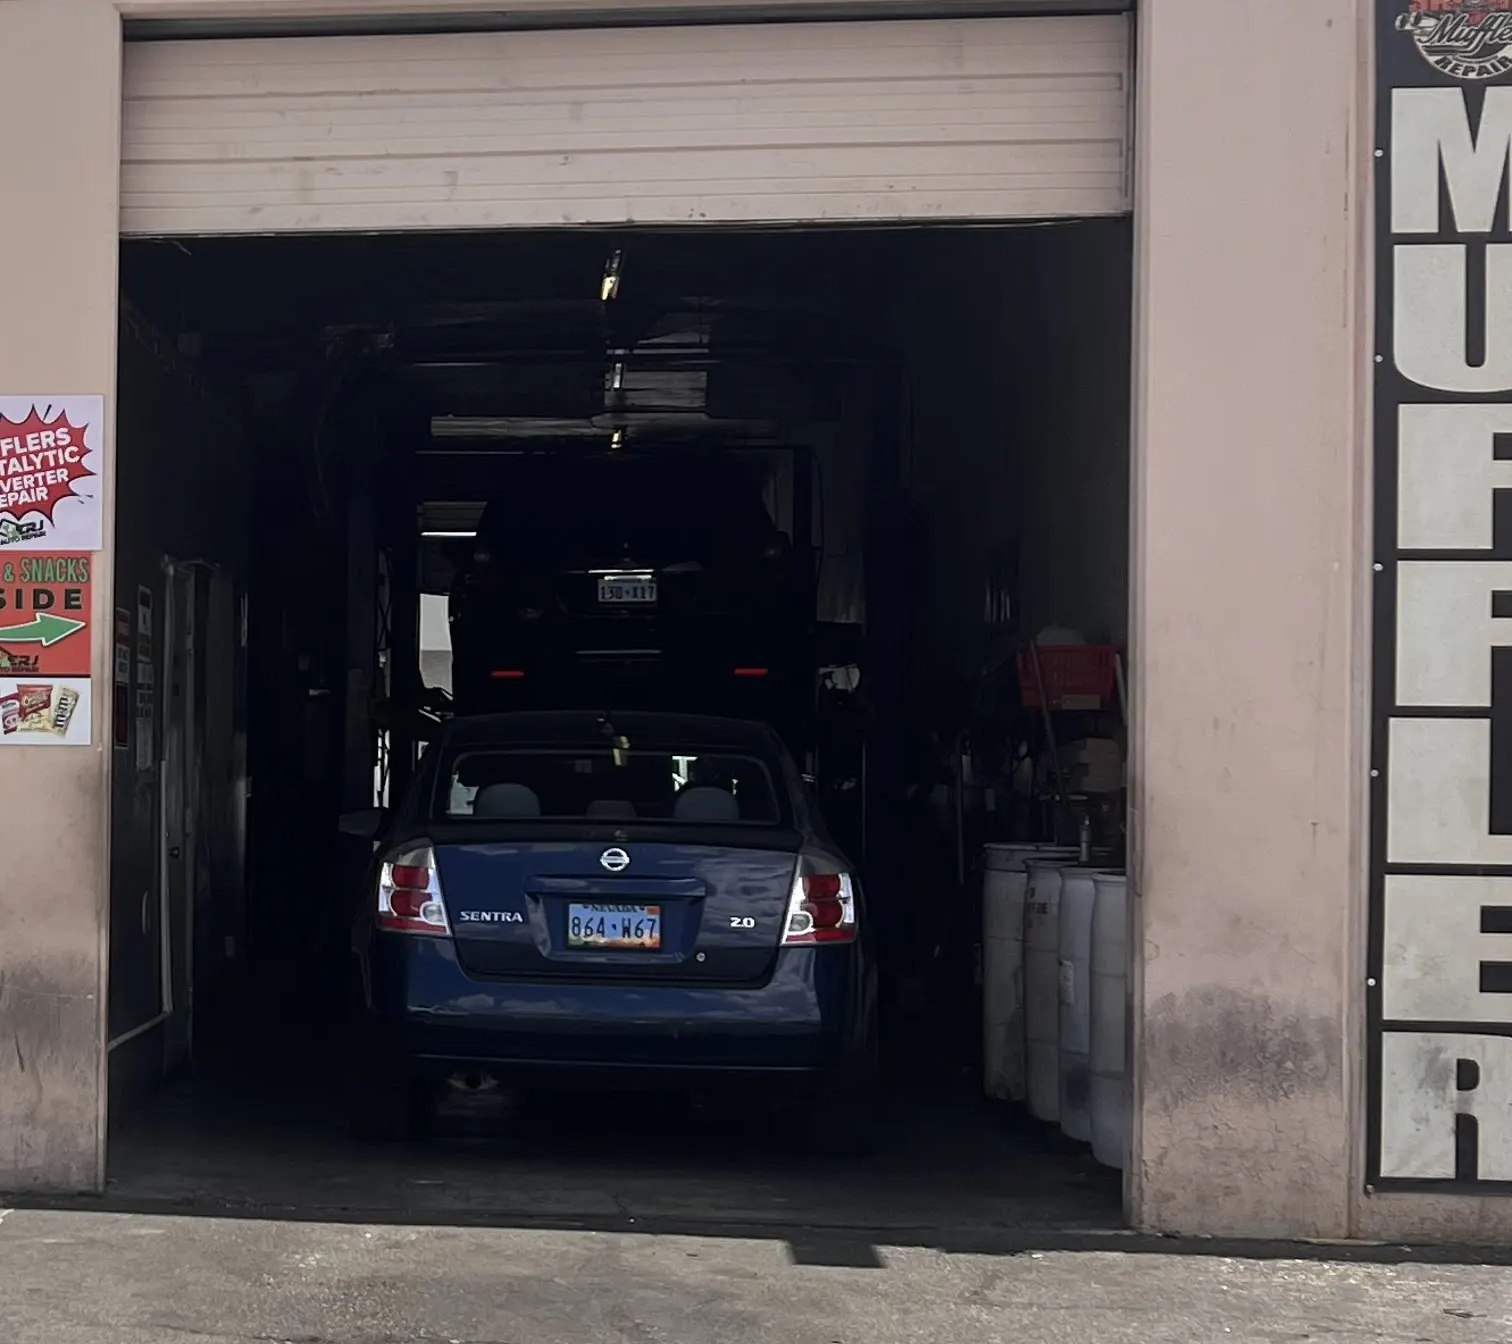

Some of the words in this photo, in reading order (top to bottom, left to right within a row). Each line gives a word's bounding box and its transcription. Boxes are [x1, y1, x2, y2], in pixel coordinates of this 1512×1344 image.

[4, 561, 15, 583] &
[20, 557, 89, 583] SNACKS
[460, 911, 523, 922] SENTRA
